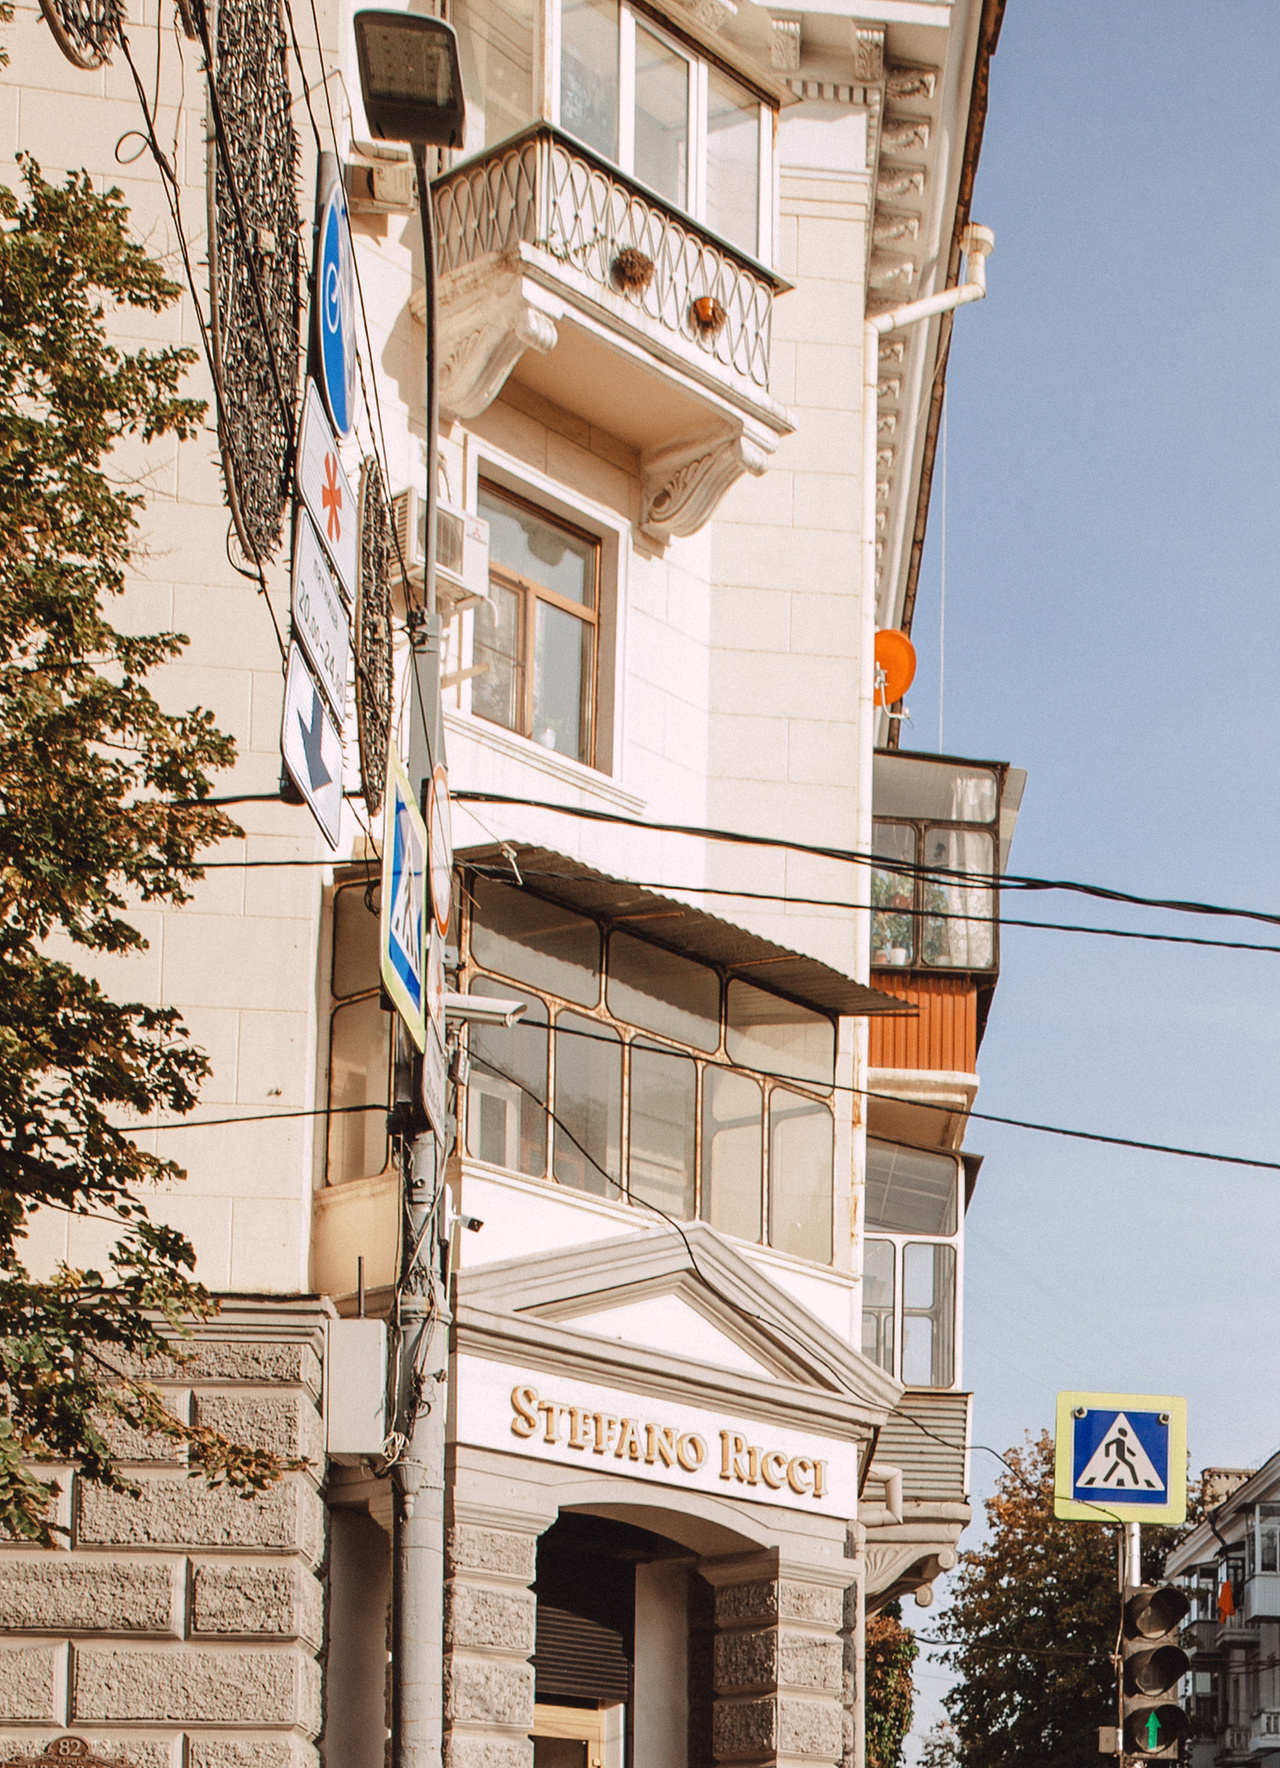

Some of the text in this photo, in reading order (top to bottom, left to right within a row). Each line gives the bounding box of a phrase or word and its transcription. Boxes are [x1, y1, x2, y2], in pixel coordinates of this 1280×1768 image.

[510, 1385, 828, 1499] STEFANO RICCI
[58, 1739, 81, 1757] 82
